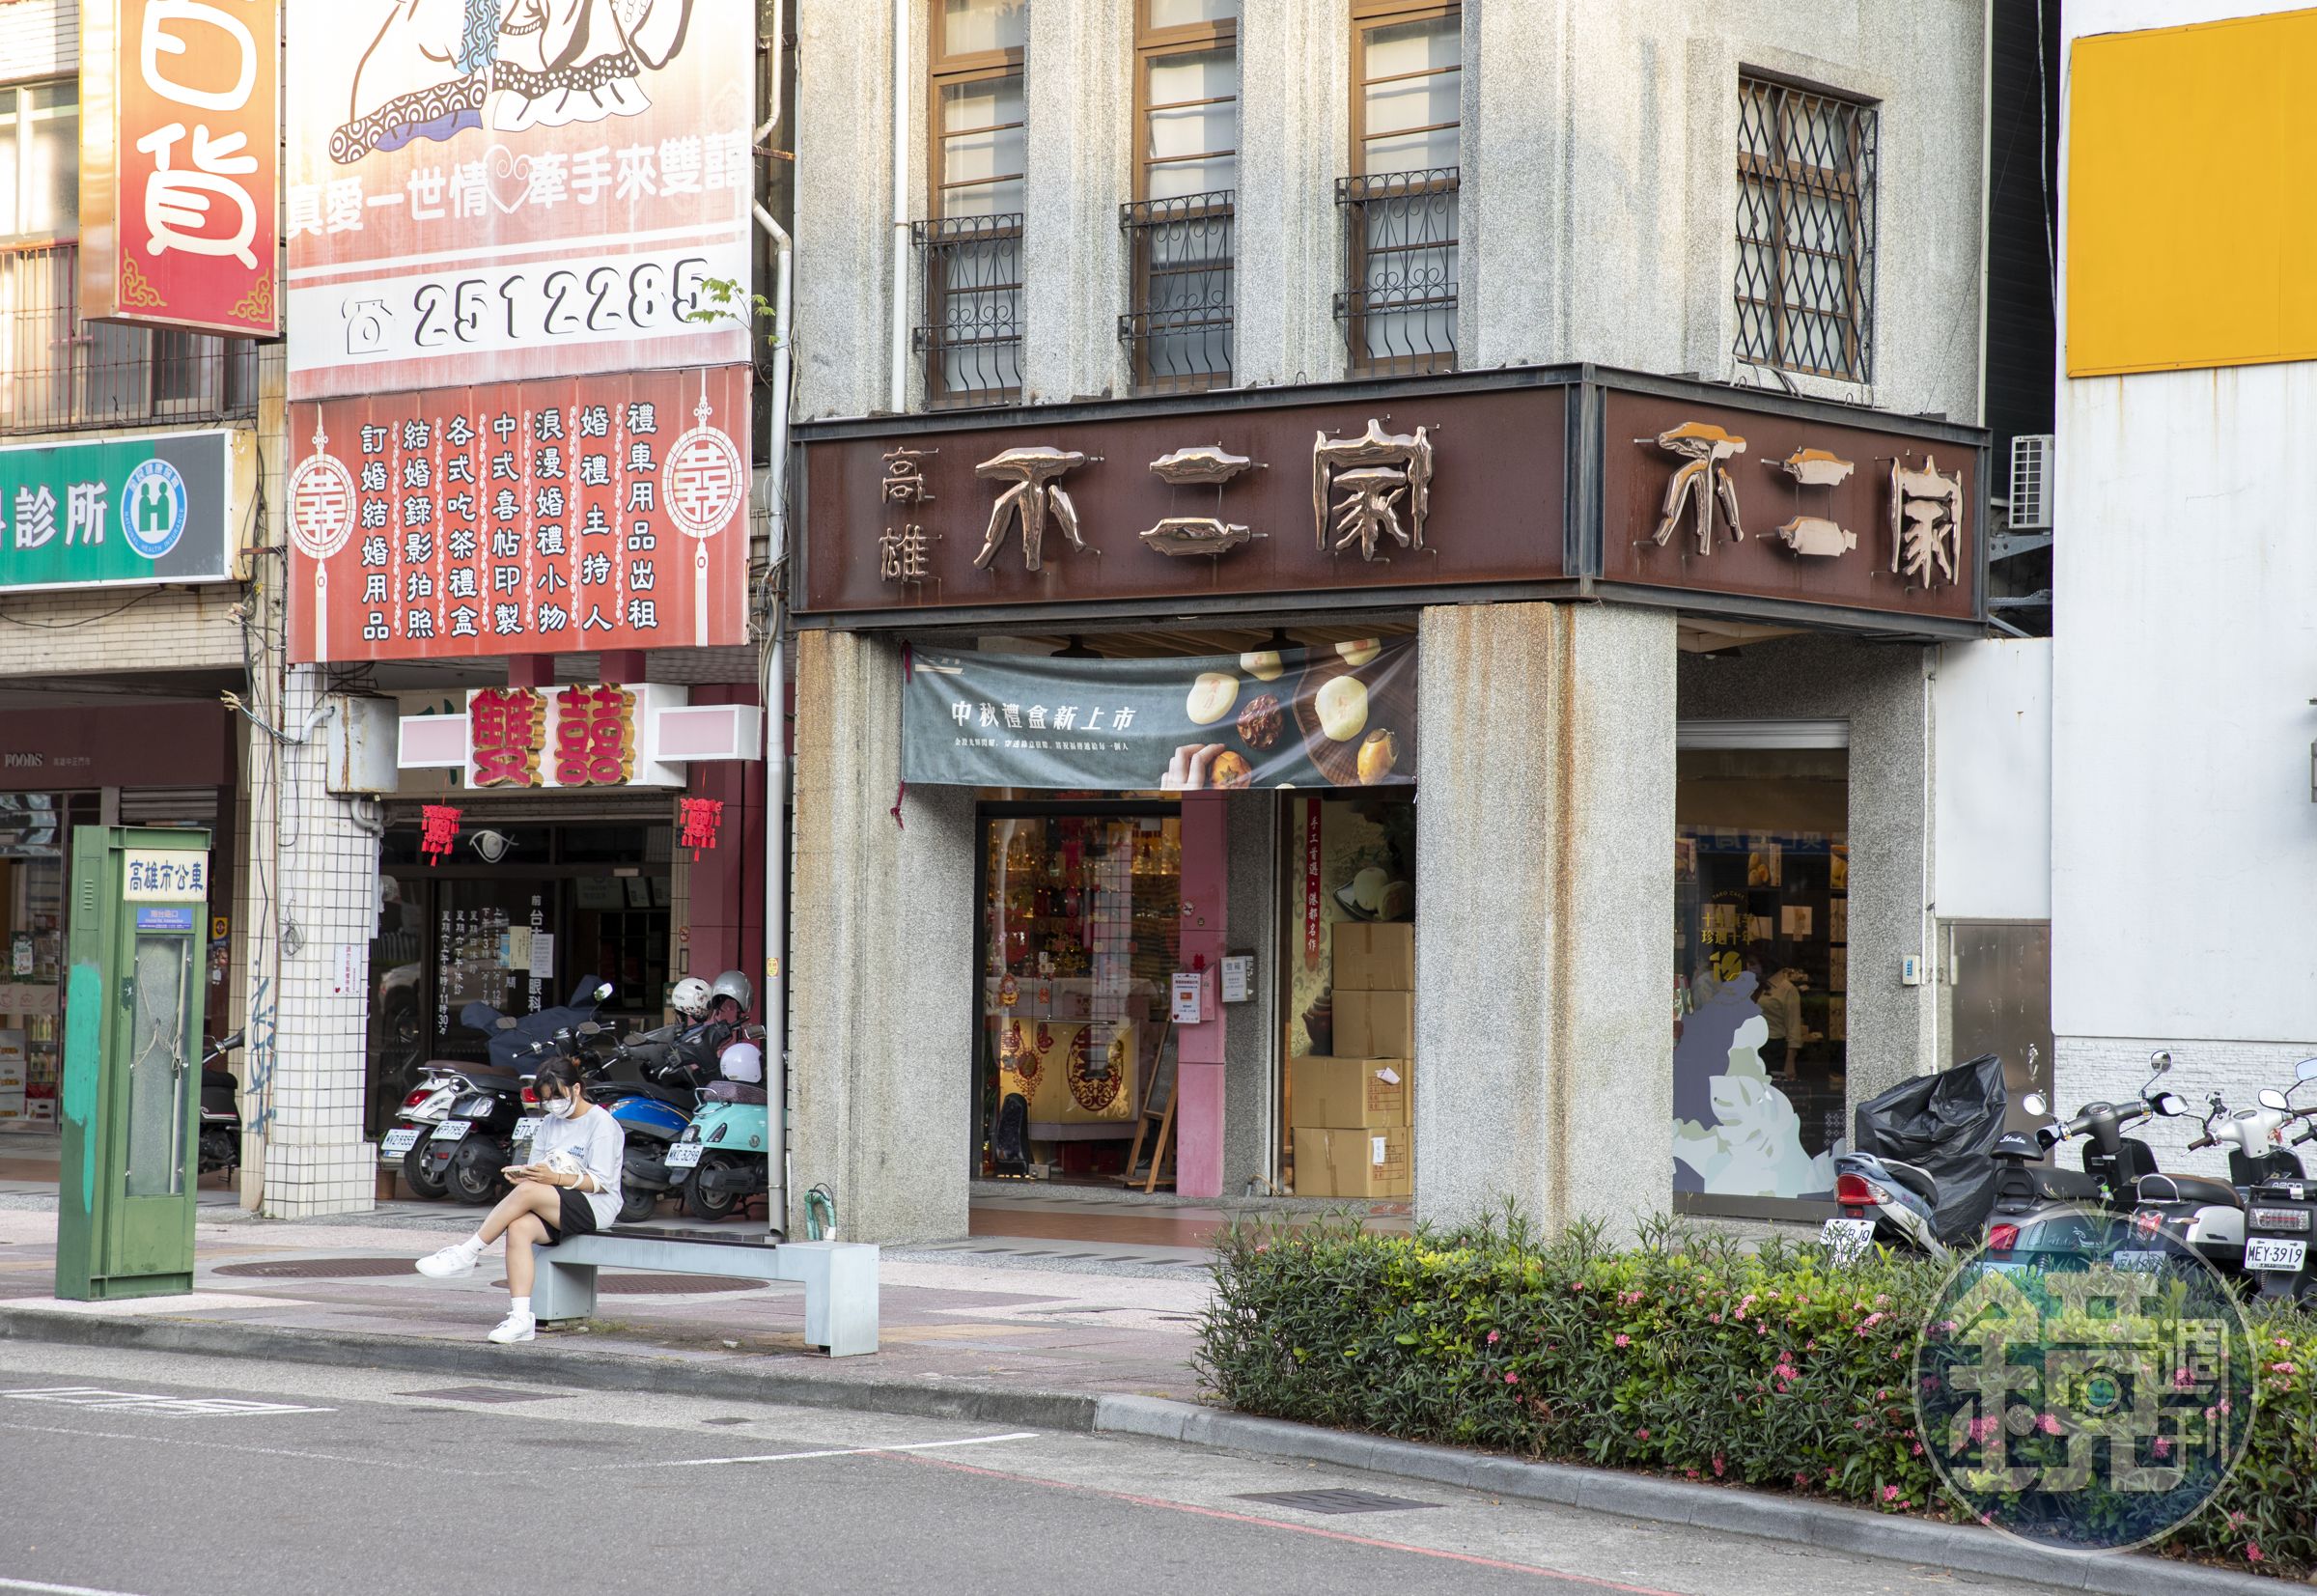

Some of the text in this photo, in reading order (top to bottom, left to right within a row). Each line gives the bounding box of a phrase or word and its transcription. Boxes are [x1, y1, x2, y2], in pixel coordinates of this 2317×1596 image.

[136, 0, 258, 269] 百貨
[287, 161, 489, 238] 真愛一世情
[0, 481, 108, 548] 診所
[360, 424, 390, 641] 訂婚結婚用品
[404, 418, 434, 639] 結婚錄影拍照
[447, 414, 478, 638] 各式吃茶禮盒
[491, 412, 523, 635] 中式喜帖印製
[535, 408, 568, 634] 浪漫婚禮小物
[580, 405, 613, 631] 婚禮主持人
[627, 402, 657, 630] 禮車用品出租
[879, 446, 928, 582] 高雄
[973, 419, 1435, 572] 不二家
[1652, 421, 1963, 589] 不二家
[4, 753, 43, 768] FOODS
[951, 700, 1136, 731] 中秋禮盒新上市
[130, 859, 204, 892] 高雄市公車
